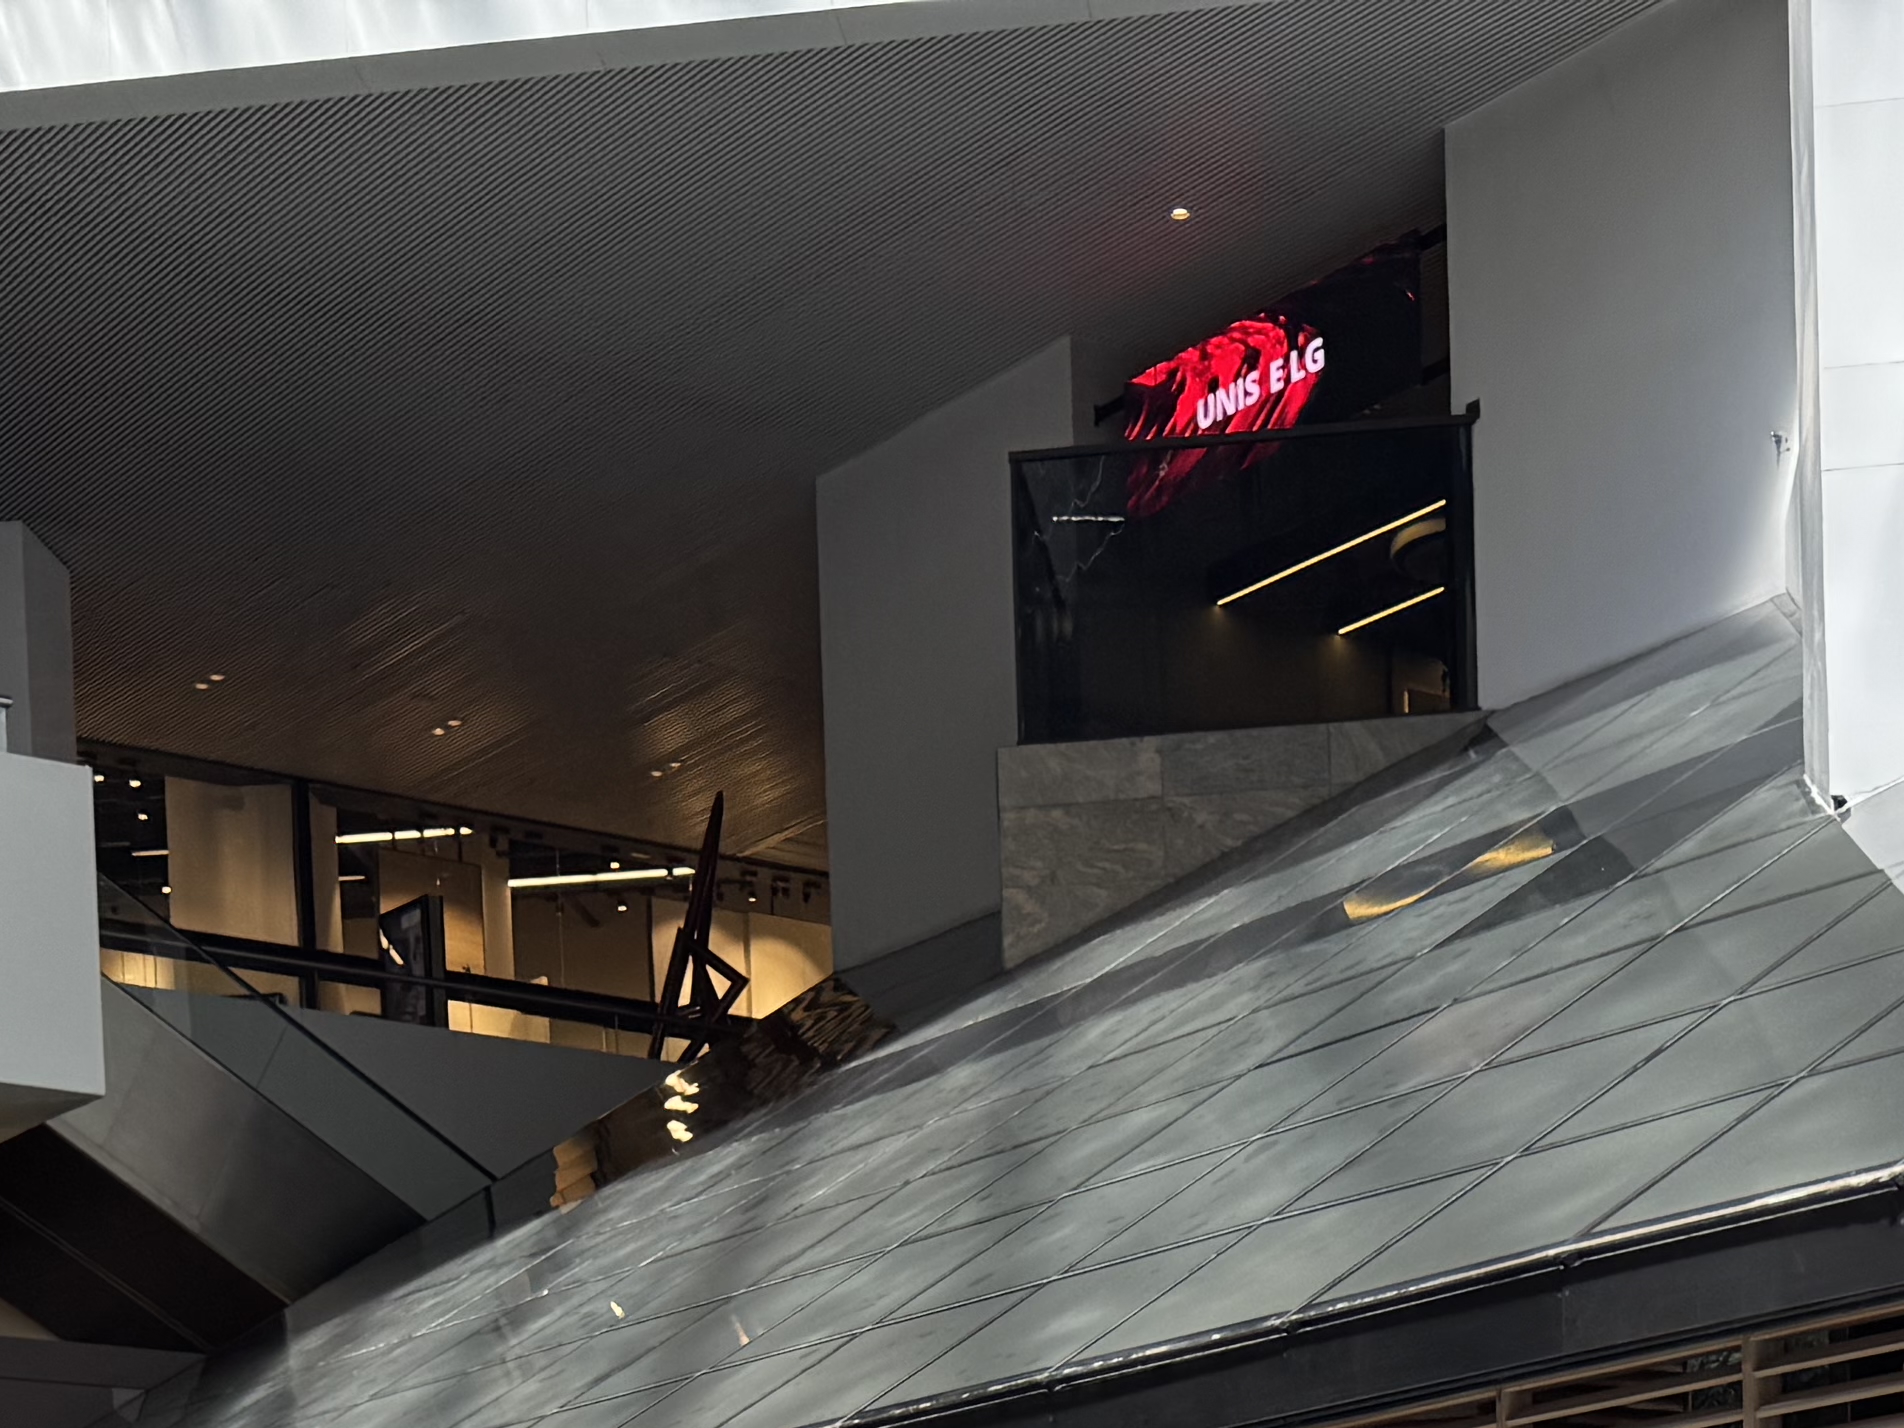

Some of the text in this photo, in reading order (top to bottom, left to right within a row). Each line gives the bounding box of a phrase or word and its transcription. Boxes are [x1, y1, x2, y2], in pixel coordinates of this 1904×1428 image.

[1196, 336, 1325, 430] UNIS E LG
